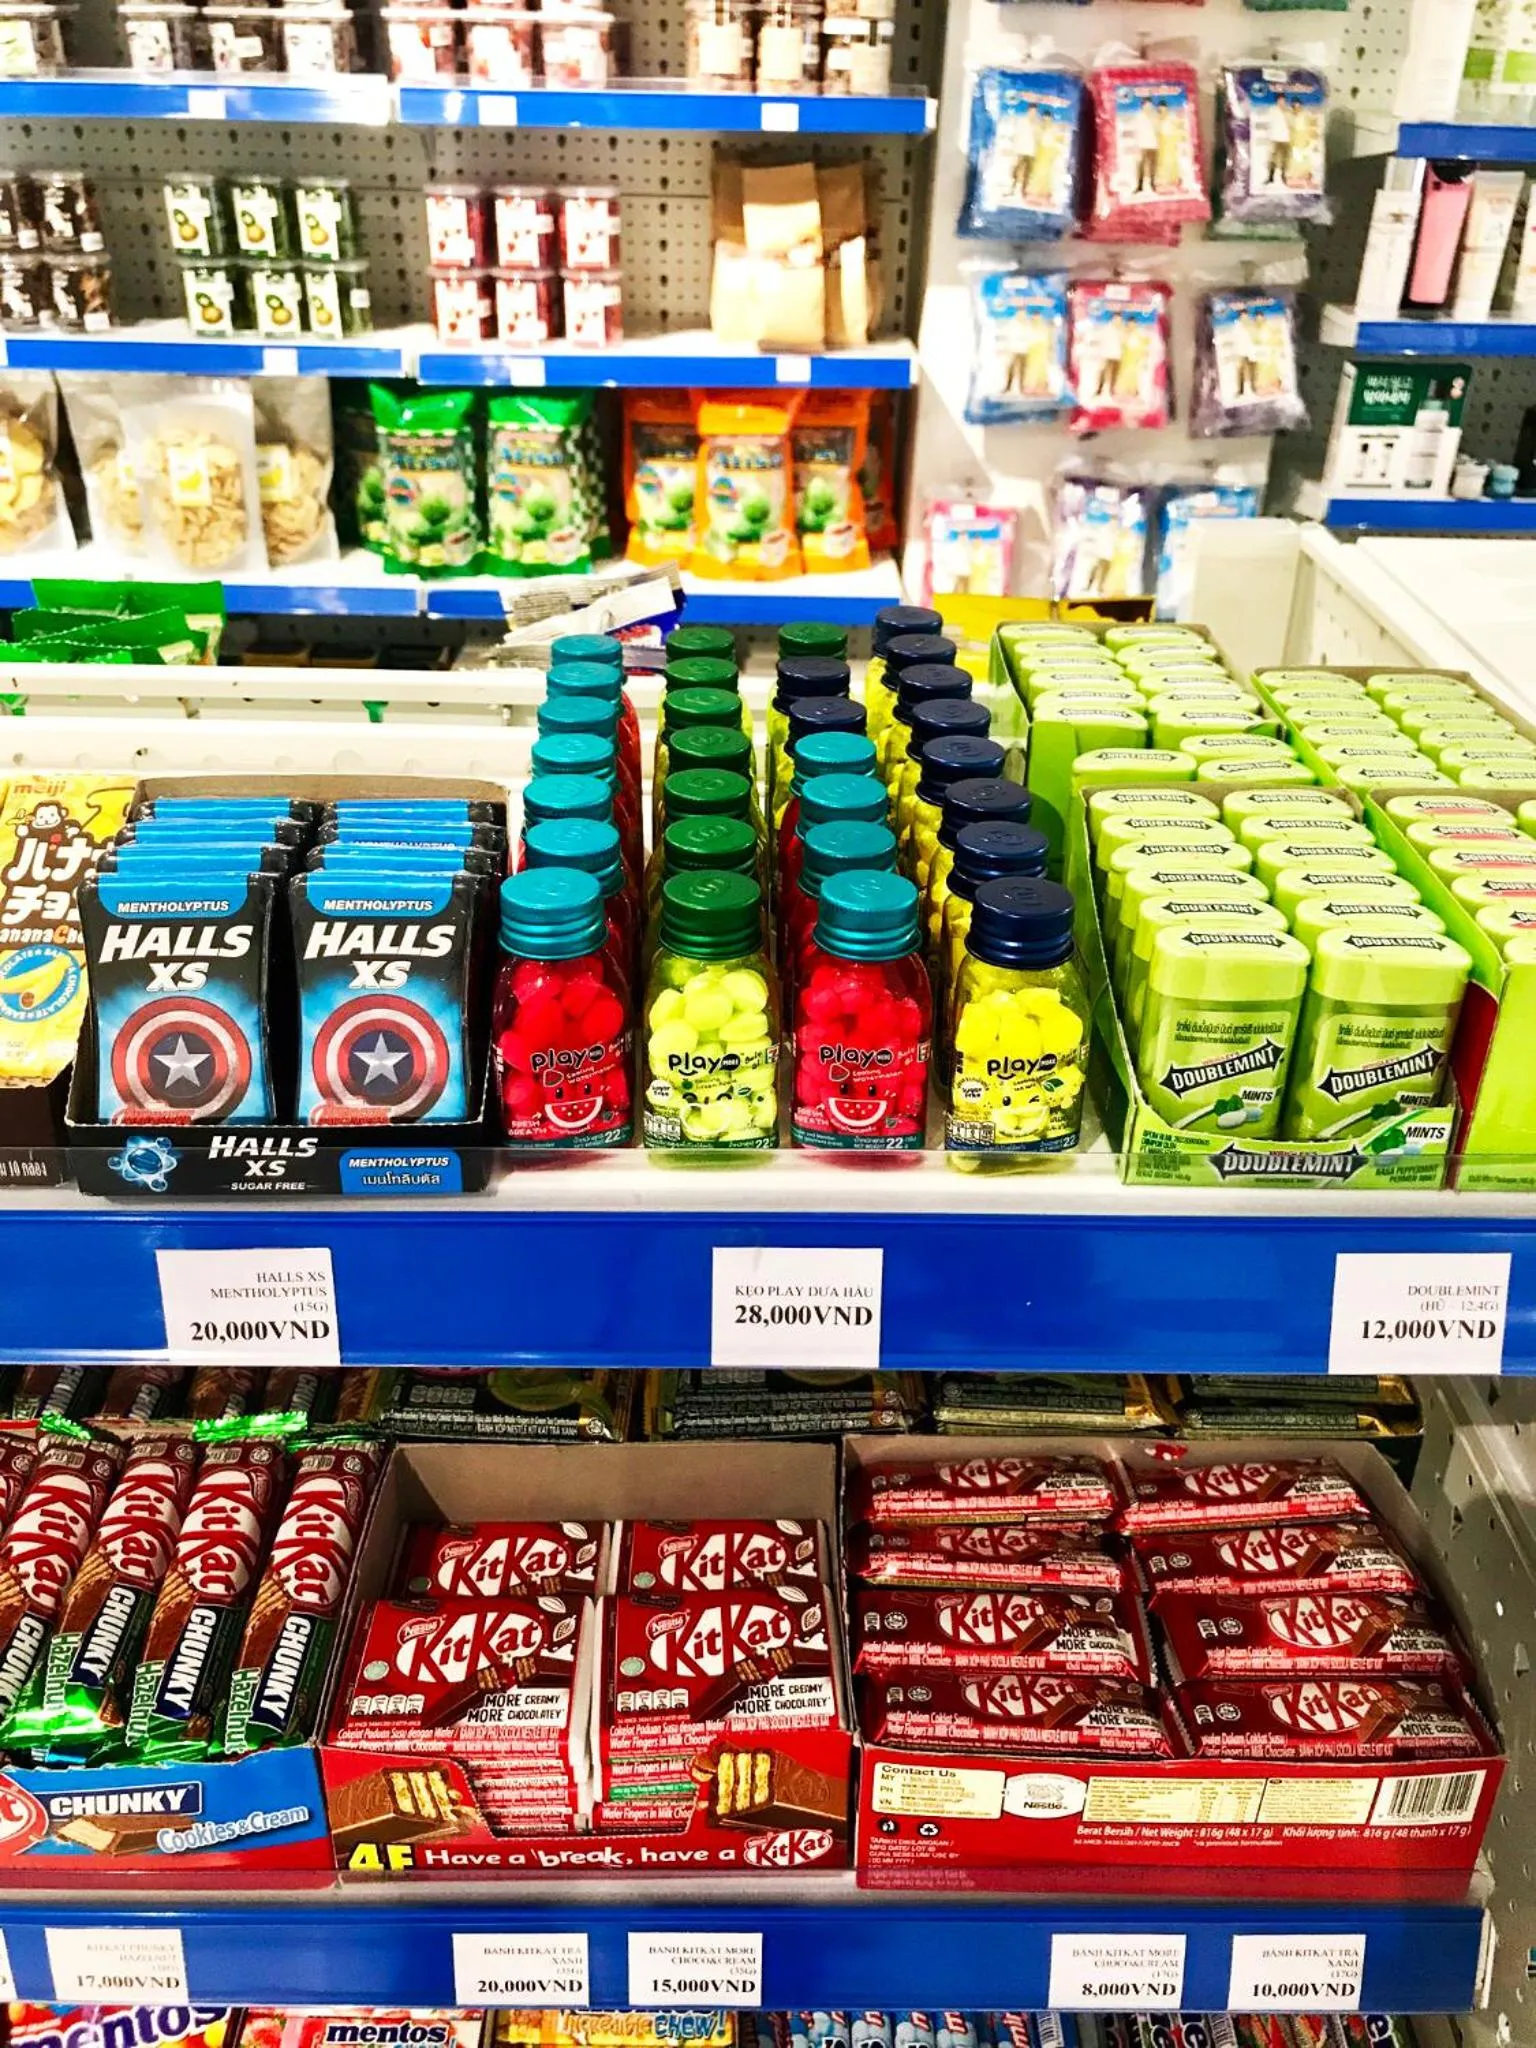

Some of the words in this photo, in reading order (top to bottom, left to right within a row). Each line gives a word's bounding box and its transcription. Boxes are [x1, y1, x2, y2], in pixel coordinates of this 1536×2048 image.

[13, 780, 67, 797] meiji
[1159, 873, 1240, 884] DOUBLEMINT
[1310, 874, 1390, 886] DOUBLEMINT
[117, 900, 230, 914] MENTHOLYPTUS
[323, 899, 434, 912] MENTHOLYPTUS
[1172, 902, 1255, 915] DOUBLEMINT
[1332, 904, 1416, 917] DOUBLEMINT
[98, 924, 254, 964] HALLS
[303, 921, 457, 960] HALLS
[1191, 933, 1279, 947] DOUBLEMINT
[1352, 936, 1440, 949] DOUBLEMINT
[145, 961, 210, 993] XS
[348, 959, 412, 990] XS
[530, 1047, 589, 1073] play
[668, 1051, 721, 1075] play
[819, 1043, 876, 1069] play
[986, 1056, 1039, 1076] play
[1171, 1044, 1275, 1091] DOUBLEMINT
[1330, 1050, 1434, 1094] DOUBLEMINT
[1242, 1089, 1274, 1102] MINTS
[605, 1128, 621, 1144] 22
[1063, 1135, 1076, 1147] 22
[1406, 1126, 1446, 1140] MINTS
[207, 1135, 318, 1160] HALLS
[886, 1137, 903, 1149] 22
[245, 1159, 287, 1177] XS
[348, 1156, 449, 1169] MENTHOLYPTUS
[1224, 1151, 1353, 1174] DOUBLEMINT
[230, 1181, 282, 1191] SUGAR
[284, 1181, 306, 1191] FREE
[256, 1271, 304, 1283] HALLS
[307, 1271, 327, 1282] XS
[210, 1286, 328, 1299] MENTHOLYPTUS
[768, 1285, 803, 1297] PLAY
[1408, 1284, 1502, 1297] DOUBLEMINT
[293, 1301, 329, 1313] (15G)
[734, 1304, 873, 1328] 28,000VND
[190, 1319, 330, 1344] 20,000VND
[1361, 1319, 1497, 1343] 12,000VND
[98, 1474, 183, 1584] KitKat
[6, 1483, 92, 1609] KitKat
[174, 1482, 261, 1598] KitKat
[271, 1489, 352, 1604] KitKat
[450, 1536, 564, 1595] KitKat
[671, 1533, 785, 1592] KitKat
[951, 1593, 1042, 1644] KitKat
[1280, 1596, 1371, 1647] KitKat
[79, 1585, 137, 1683] CHUNKY
[664, 1604, 788, 1677] KitKat
[408, 1612, 539, 1683] KitKat
[1056, 1639, 1087, 1651] MORE
[1389, 1639, 1421, 1651] MORE
[163, 1606, 218, 1717] CHUNKY
[259, 1615, 312, 1723] CHUNKY
[750, 1684, 787, 1699] MORE
[788, 1683, 824, 1695] CREAMY
[974, 1673, 1075, 1717] KitKat
[126, 1660, 167, 1748] Hazelnut
[484, 1694, 523, 1708] MORE
[525, 1694, 561, 1706] CREAMY
[735, 1699, 773, 1715] MORE
[774, 1697, 828, 1711] CHOCOLATEY
[1280, 1681, 1378, 1734] KitKat
[223, 1668, 263, 1756] Hazelnut
[467, 1708, 505, 1723] MORE
[507, 1708, 563, 1720] CHOCOLATEY
[1089, 1714, 1121, 1726] MORE
[706, 1719, 726, 1731] Wafer
[1401, 1723, 1433, 1736] MORE
[610, 1737, 631, 1749] Wafer
[632, 1736, 659, 1752] Fingers
[661, 1736, 668, 1746] in
[668, 1734, 683, 1746] Milk
[612, 1763, 634, 1776] Wafer
[634, 1761, 661, 1778] Fingers
[668, 1760, 684, 1773] Milk
[881, 1764, 936, 1777] Contact
[938, 1769, 957, 1778] Us
[50, 1788, 189, 1817] CHUNKY
[601, 1807, 624, 1819] Wafer
[624, 1806, 650, 1822] Fingers
[657, 1805, 673, 1818] Milk
[157, 1820, 237, 1855] Cookies
[238, 1820, 248, 1834] &
[249, 1805, 309, 1834] Cream
[1076, 1825, 1102, 1836] Berat
[1104, 1825, 1134, 1837] Bersih
[1141, 1827, 1158, 1837] Net
[1160, 1826, 1194, 1839] Weight
[1363, 1828, 1381, 1838] 816
[1391, 1828, 1408, 1839] (48
[1409, 1827, 1438, 1838] thanh
[424, 1849, 501, 1866] Have
[508, 1852, 526, 1865] a
[641, 1846, 709, 1863] have
[718, 1848, 736, 1862] a
[754, 1830, 828, 1867] KitKat
[1327, 1959, 1359, 1968] XANH
[77, 1974, 181, 1990] 17,000VND
[477, 1979, 583, 1994] 20,000VND
[652, 1979, 756, 1994] 15,000VND
[1082, 1983, 1177, 1998] 8,000VND
[1252, 1983, 1356, 1998] 10,000VND
[325, 2022, 449, 2044] mentos
